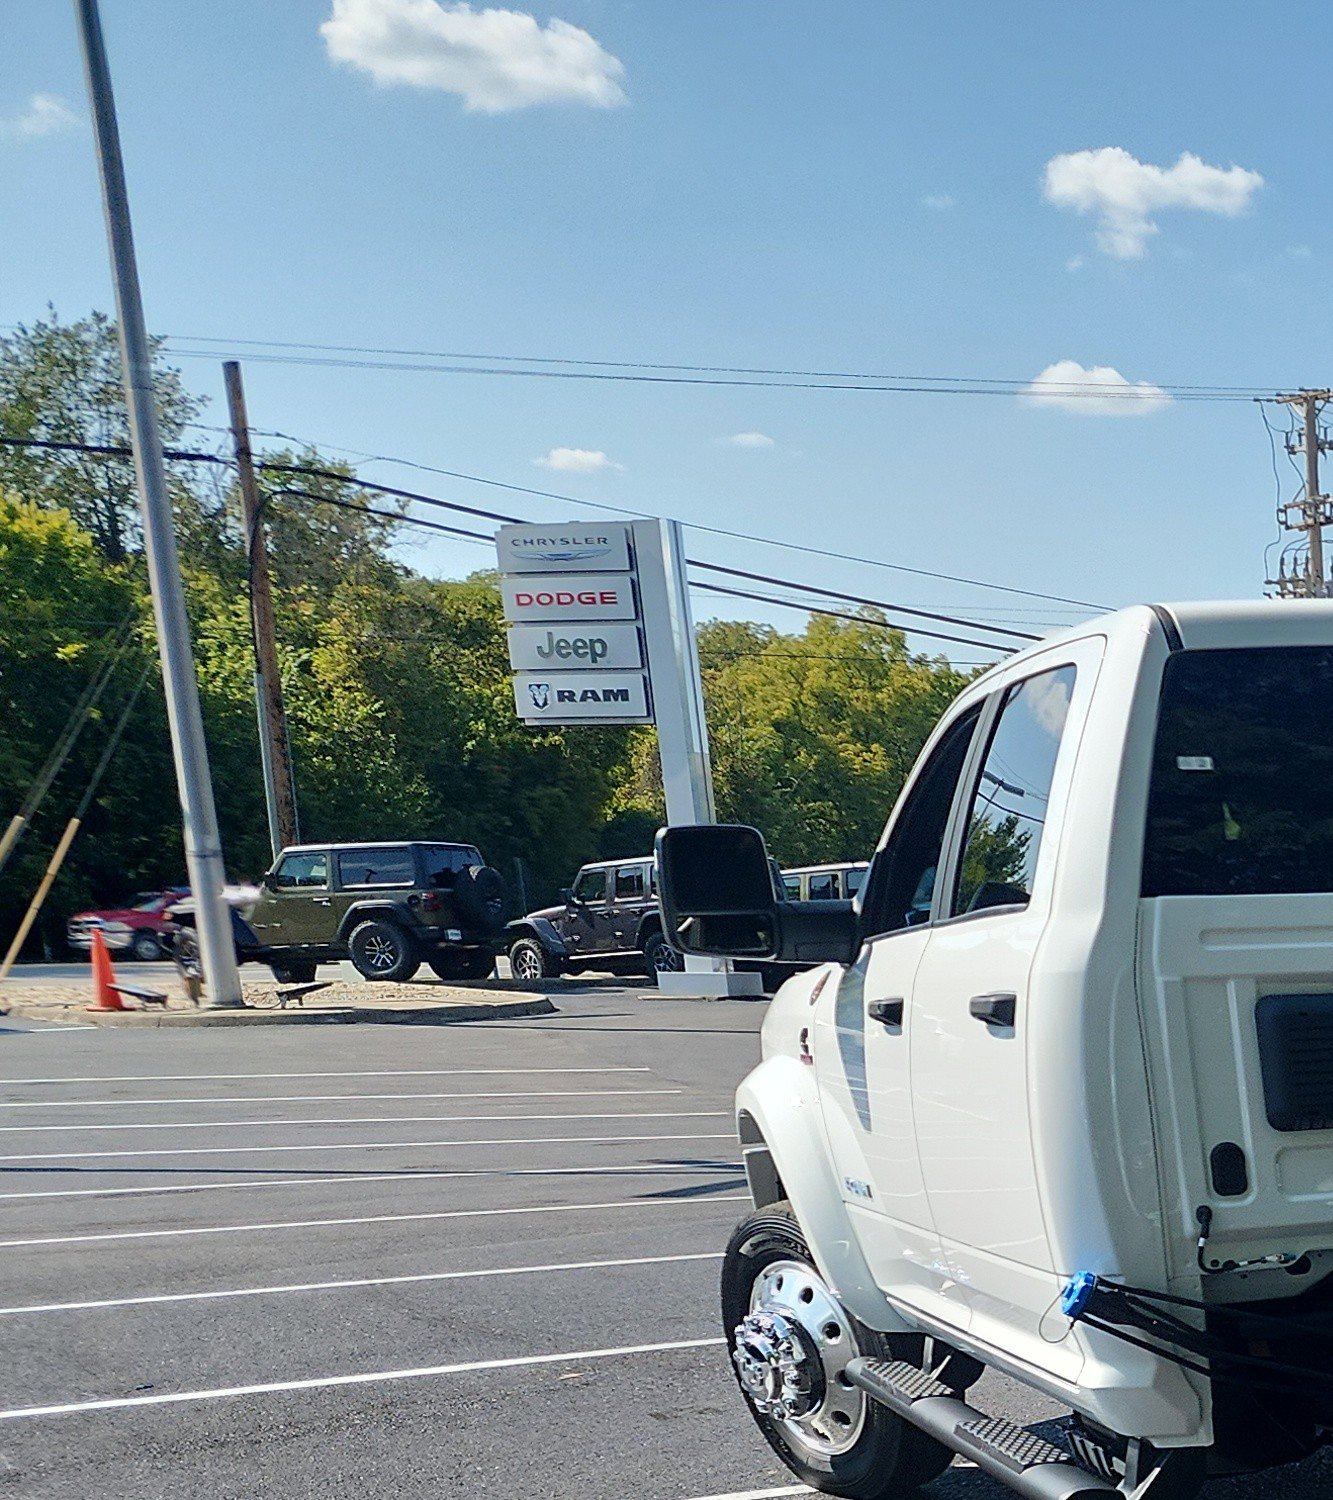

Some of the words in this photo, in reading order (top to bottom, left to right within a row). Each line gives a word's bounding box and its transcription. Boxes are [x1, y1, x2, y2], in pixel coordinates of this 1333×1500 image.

[511, 537, 609, 547] CHRYSLER
[515, 591, 618, 606] DODGE
[536, 631, 608, 663] Jeep
[556, 688, 630, 702] RAM
